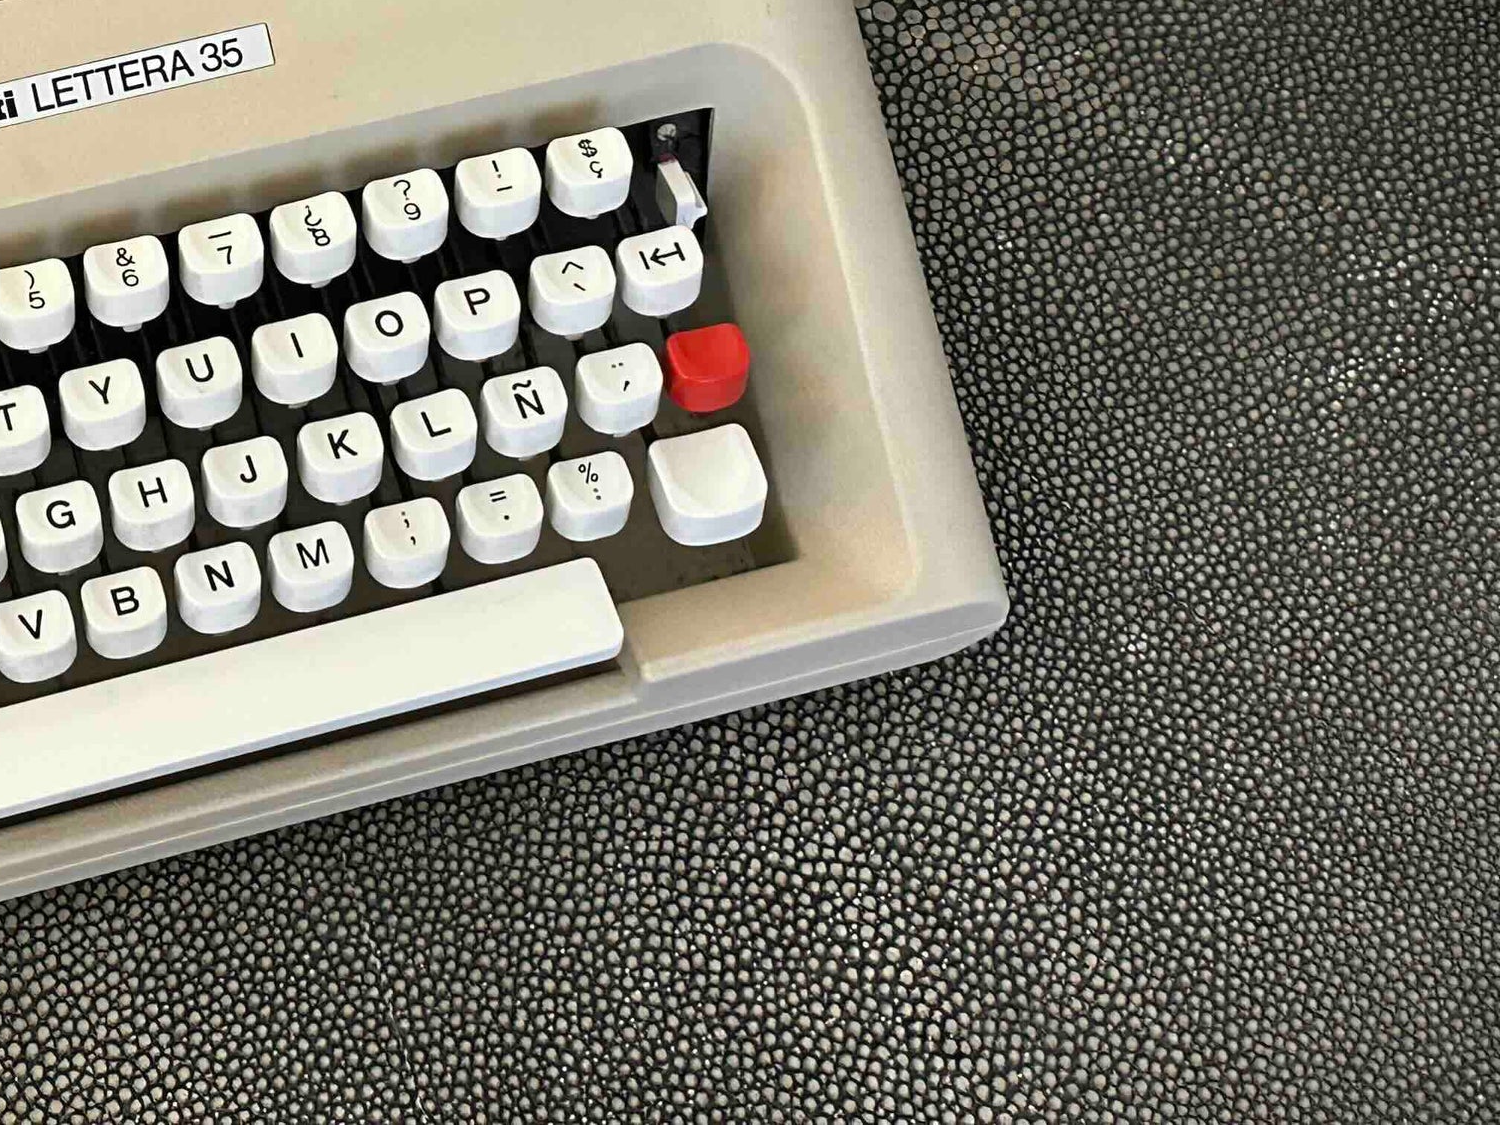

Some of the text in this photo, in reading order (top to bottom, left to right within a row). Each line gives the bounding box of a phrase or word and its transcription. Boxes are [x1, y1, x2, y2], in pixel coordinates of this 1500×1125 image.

[31, 49, 195, 112] LETTERA
[199, 38, 244, 73] 35
[578, 139, 597, 157] $
[394, 180, 410, 200] ?
[404, 203, 421, 220] 9
[314, 227, 331, 246] 8
[116, 248, 135, 266] &
[217, 246, 232, 264] 7
[23, 269, 35, 290] )
[122, 269, 139, 287] 6
[29, 290, 46, 310] 5
[464, 288, 490, 315] P
[375, 310, 403, 337] O
[291, 333, 303, 357] I
[186, 354, 214, 382] U
[89, 376, 110, 404] Y
[512, 380, 545, 419] Ñ
[421, 412, 451, 437] L
[327, 429, 357, 459] K
[240, 455, 257, 483] J
[578, 462, 598, 484] %
[138, 477, 167, 508] H
[46, 500, 76, 529] G
[296, 538, 329, 569] M
[204, 561, 234, 591] N
[111, 586, 139, 616] B
[18, 610, 42, 639] V
